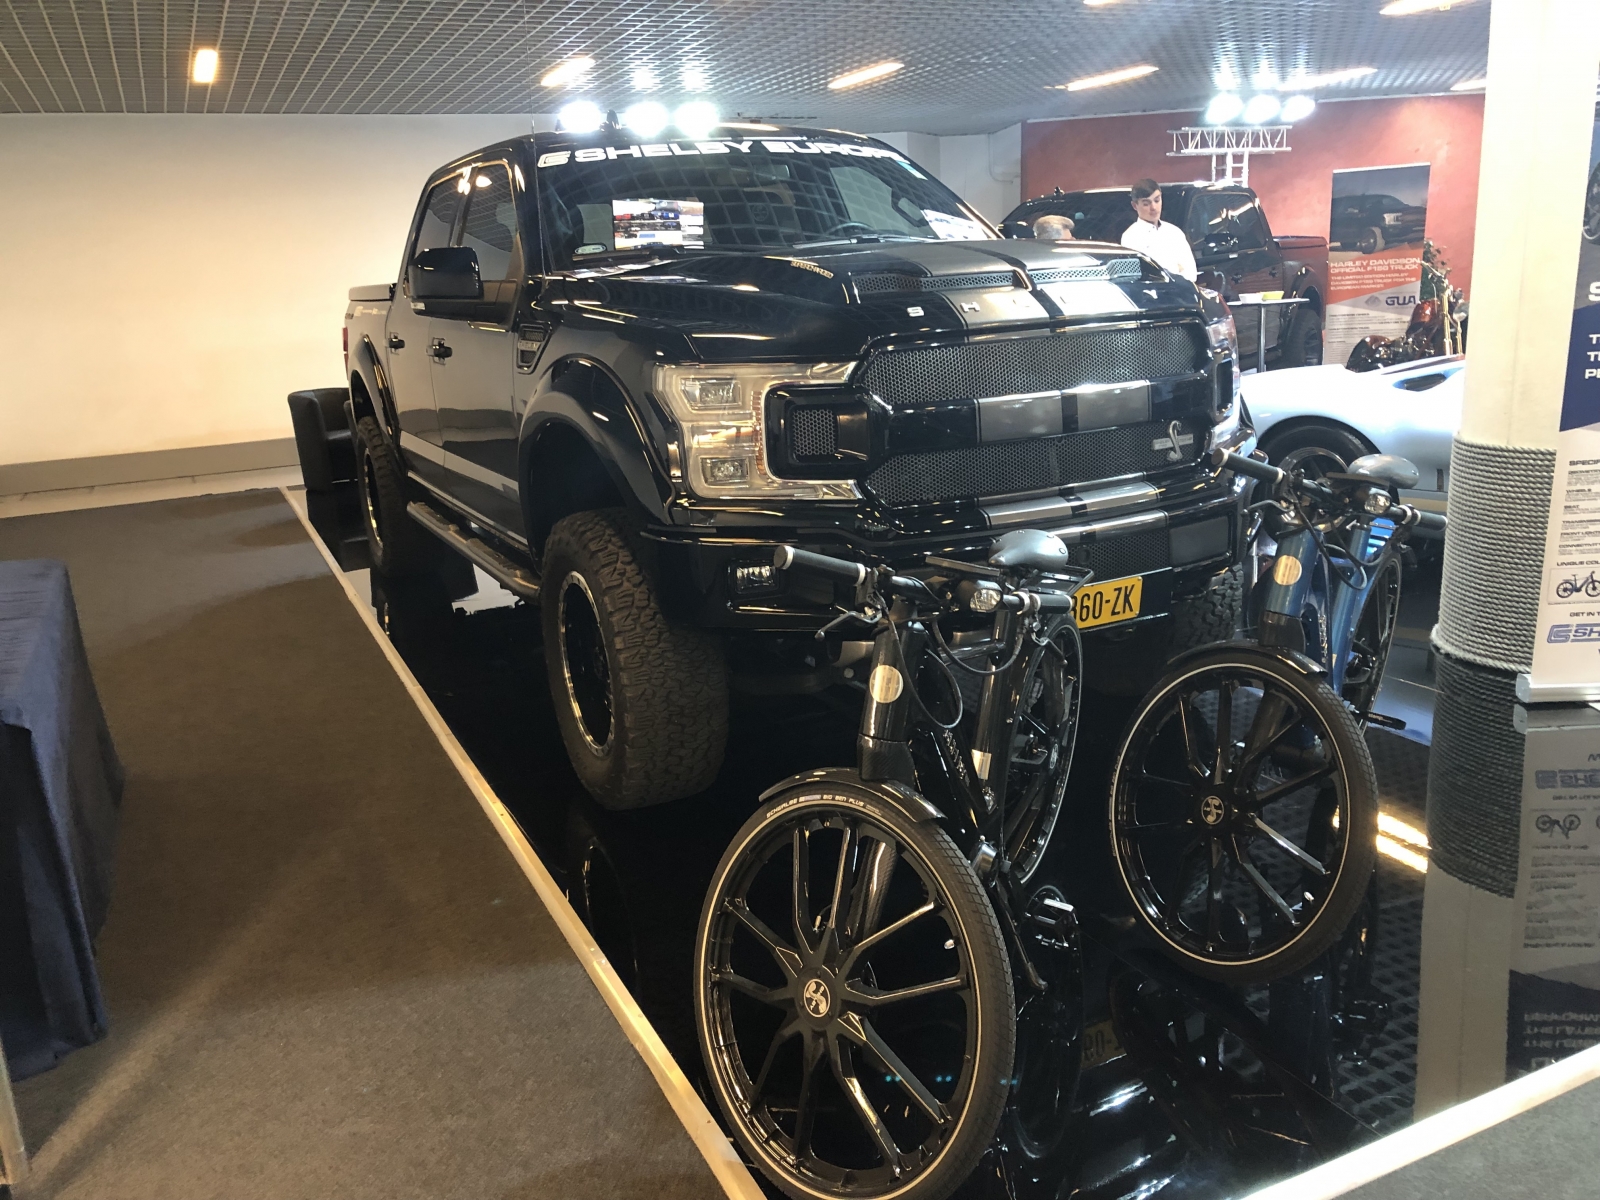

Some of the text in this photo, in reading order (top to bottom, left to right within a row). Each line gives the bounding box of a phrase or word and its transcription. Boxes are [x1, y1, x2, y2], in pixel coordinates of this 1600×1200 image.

[574, 141, 753, 163] SHELBY
[1369, 257, 1420, 266] DAVIDSON
[1385, 295, 1416, 306] GUA
